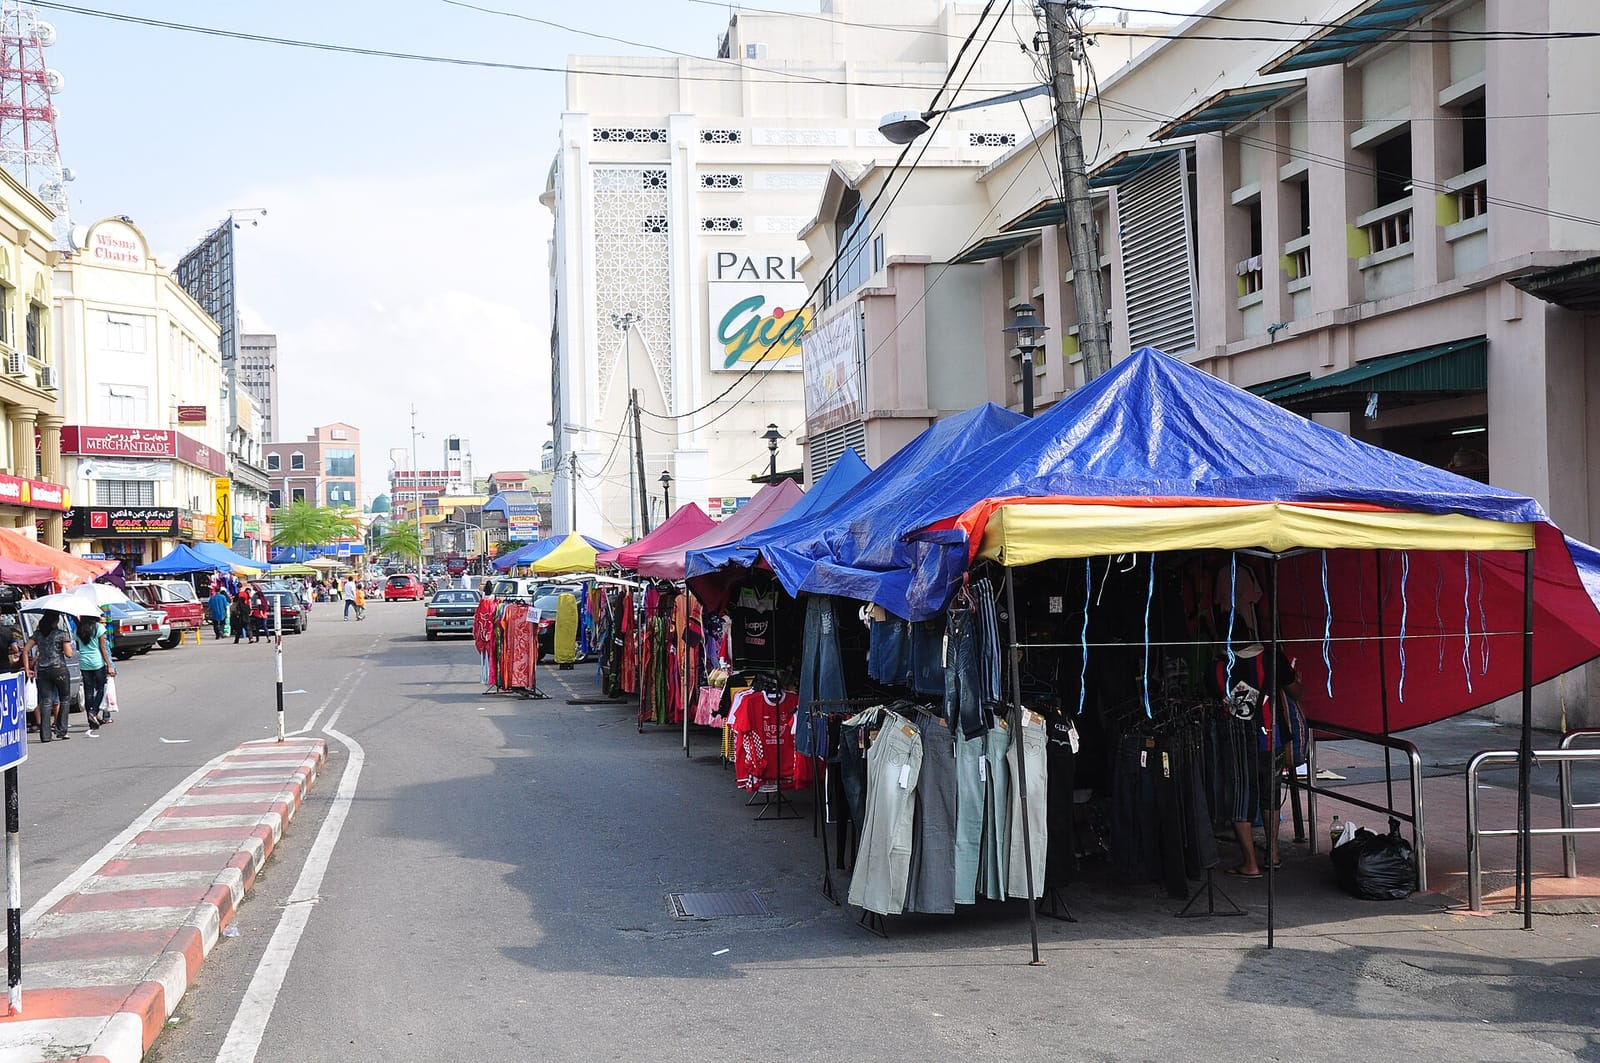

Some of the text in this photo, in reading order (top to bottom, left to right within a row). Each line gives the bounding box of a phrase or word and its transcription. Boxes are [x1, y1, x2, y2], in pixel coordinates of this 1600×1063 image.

[96, 234, 136, 250] Wisma
[95, 246, 139, 263] Charis
[86, 439, 170, 453] MERCHANTRADE
[112, 519, 142, 527] KAK
